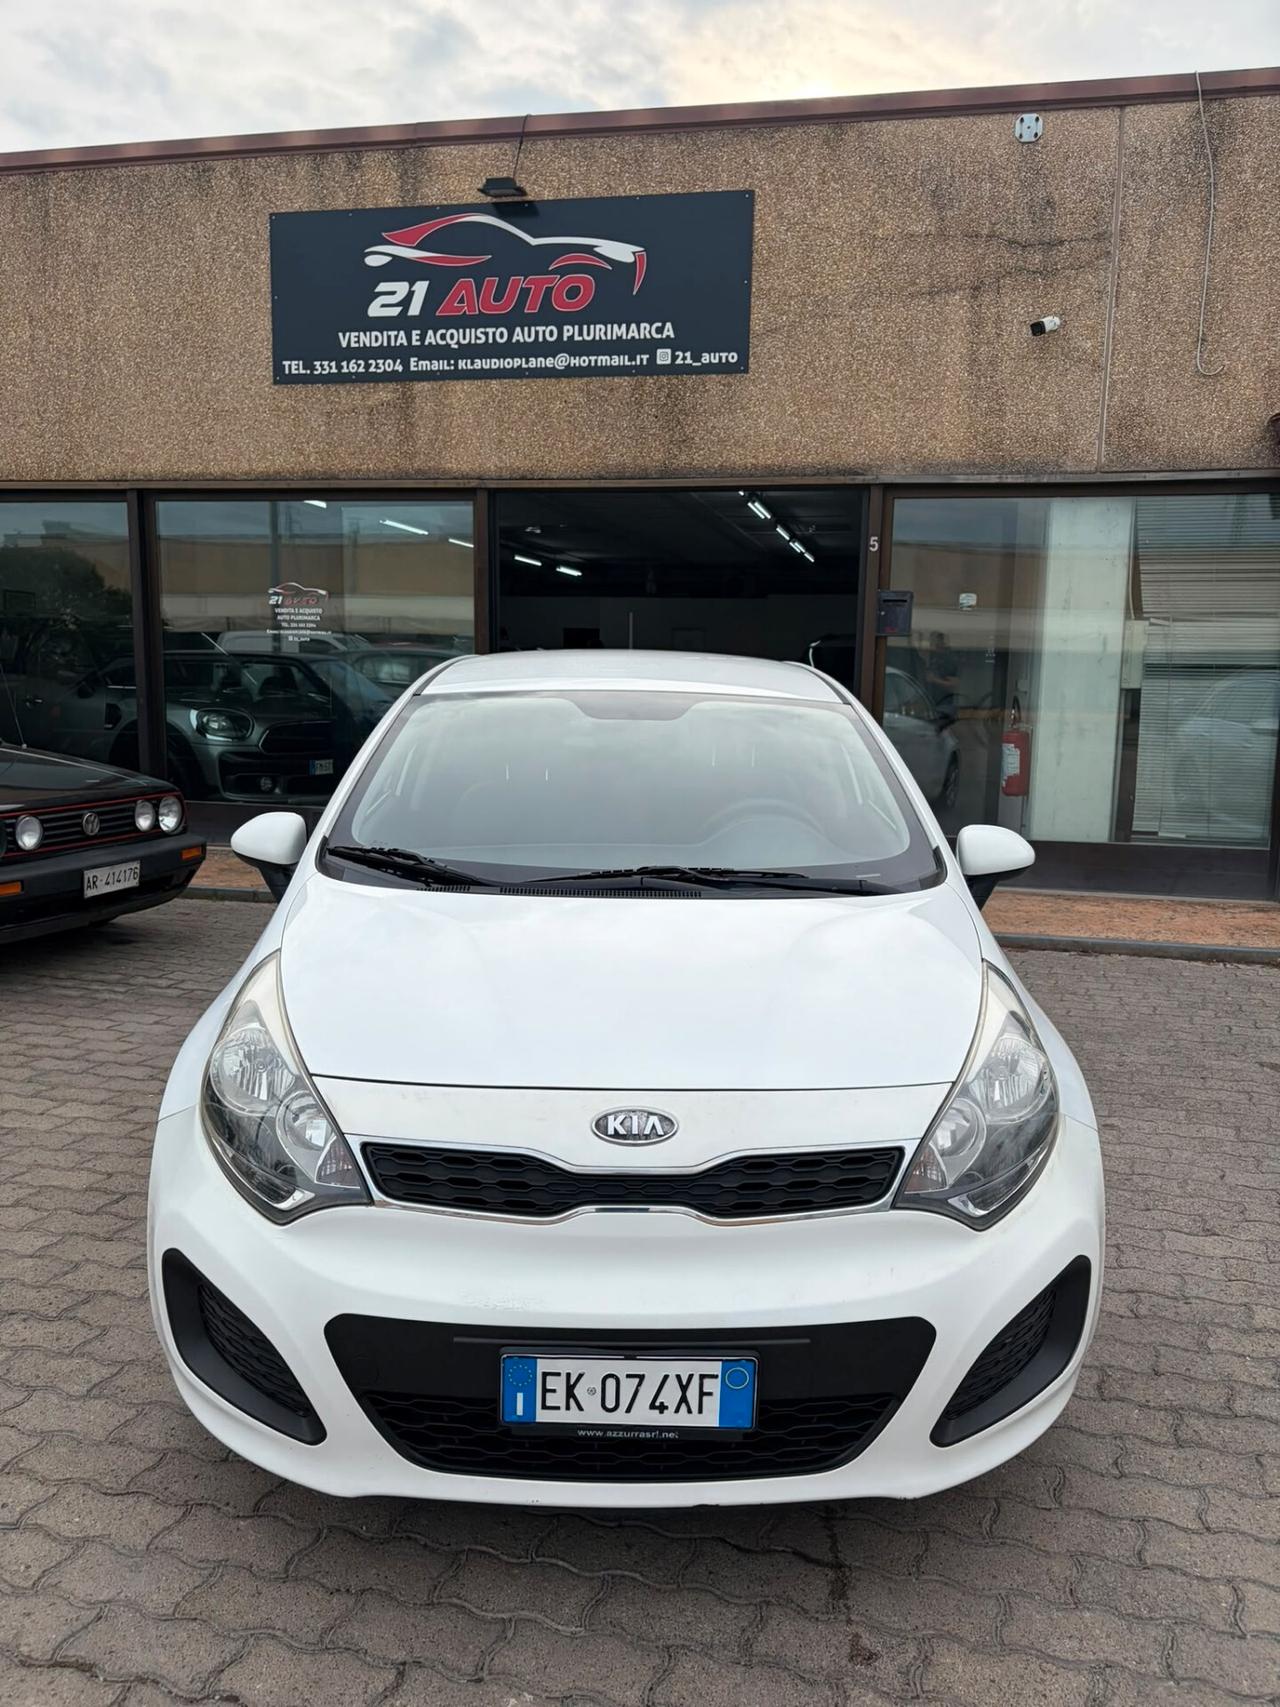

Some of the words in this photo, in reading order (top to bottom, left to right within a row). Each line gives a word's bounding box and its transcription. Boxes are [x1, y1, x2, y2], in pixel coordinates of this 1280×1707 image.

[367, 280, 430, 318] 21
[436, 274, 596, 317] AUTO
[338, 330, 408, 349] VENDITA
[411, 330, 421, 346] E
[424, 327, 508, 349] ACQUISTO
[512, 325, 558, 343] AUTO
[563, 321, 675, 342] PLURIMARCA
[282, 360, 311, 375] TEL.
[313, 360, 338, 374] 331
[341, 359, 366, 373] 162
[368, 358, 403, 373] 2304
[869, 536, 879, 552] 5
[268, 596, 282, 604] 21
[607, 1115, 665, 1136] KIA
[540, 1371, 585, 1412] EK
[600, 1373, 719, 1415] 074XF
